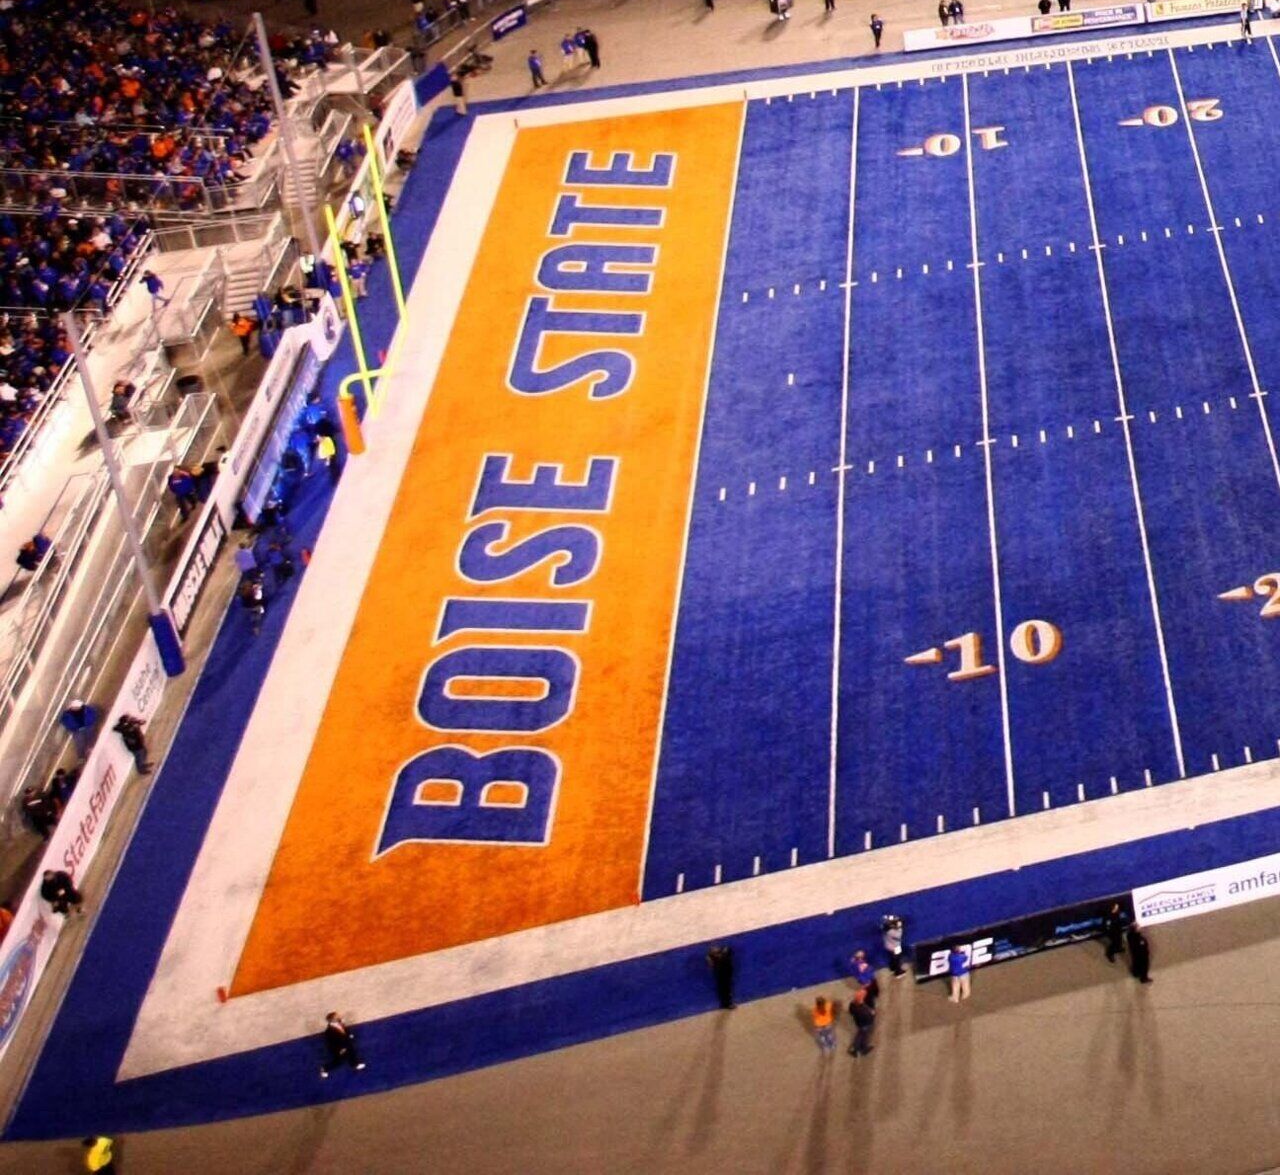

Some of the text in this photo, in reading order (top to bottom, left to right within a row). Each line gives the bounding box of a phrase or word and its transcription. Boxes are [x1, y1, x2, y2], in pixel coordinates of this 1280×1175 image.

[1142, 98, 1225, 130] 20
[922, 125, 1009, 160] 10
[505, 149, 677, 402] STATE
[371, 453, 620, 864] BOISE
[944, 619, 1063, 682] 10
[1140, 887, 1217, 912] AMERICAN FAMILY
